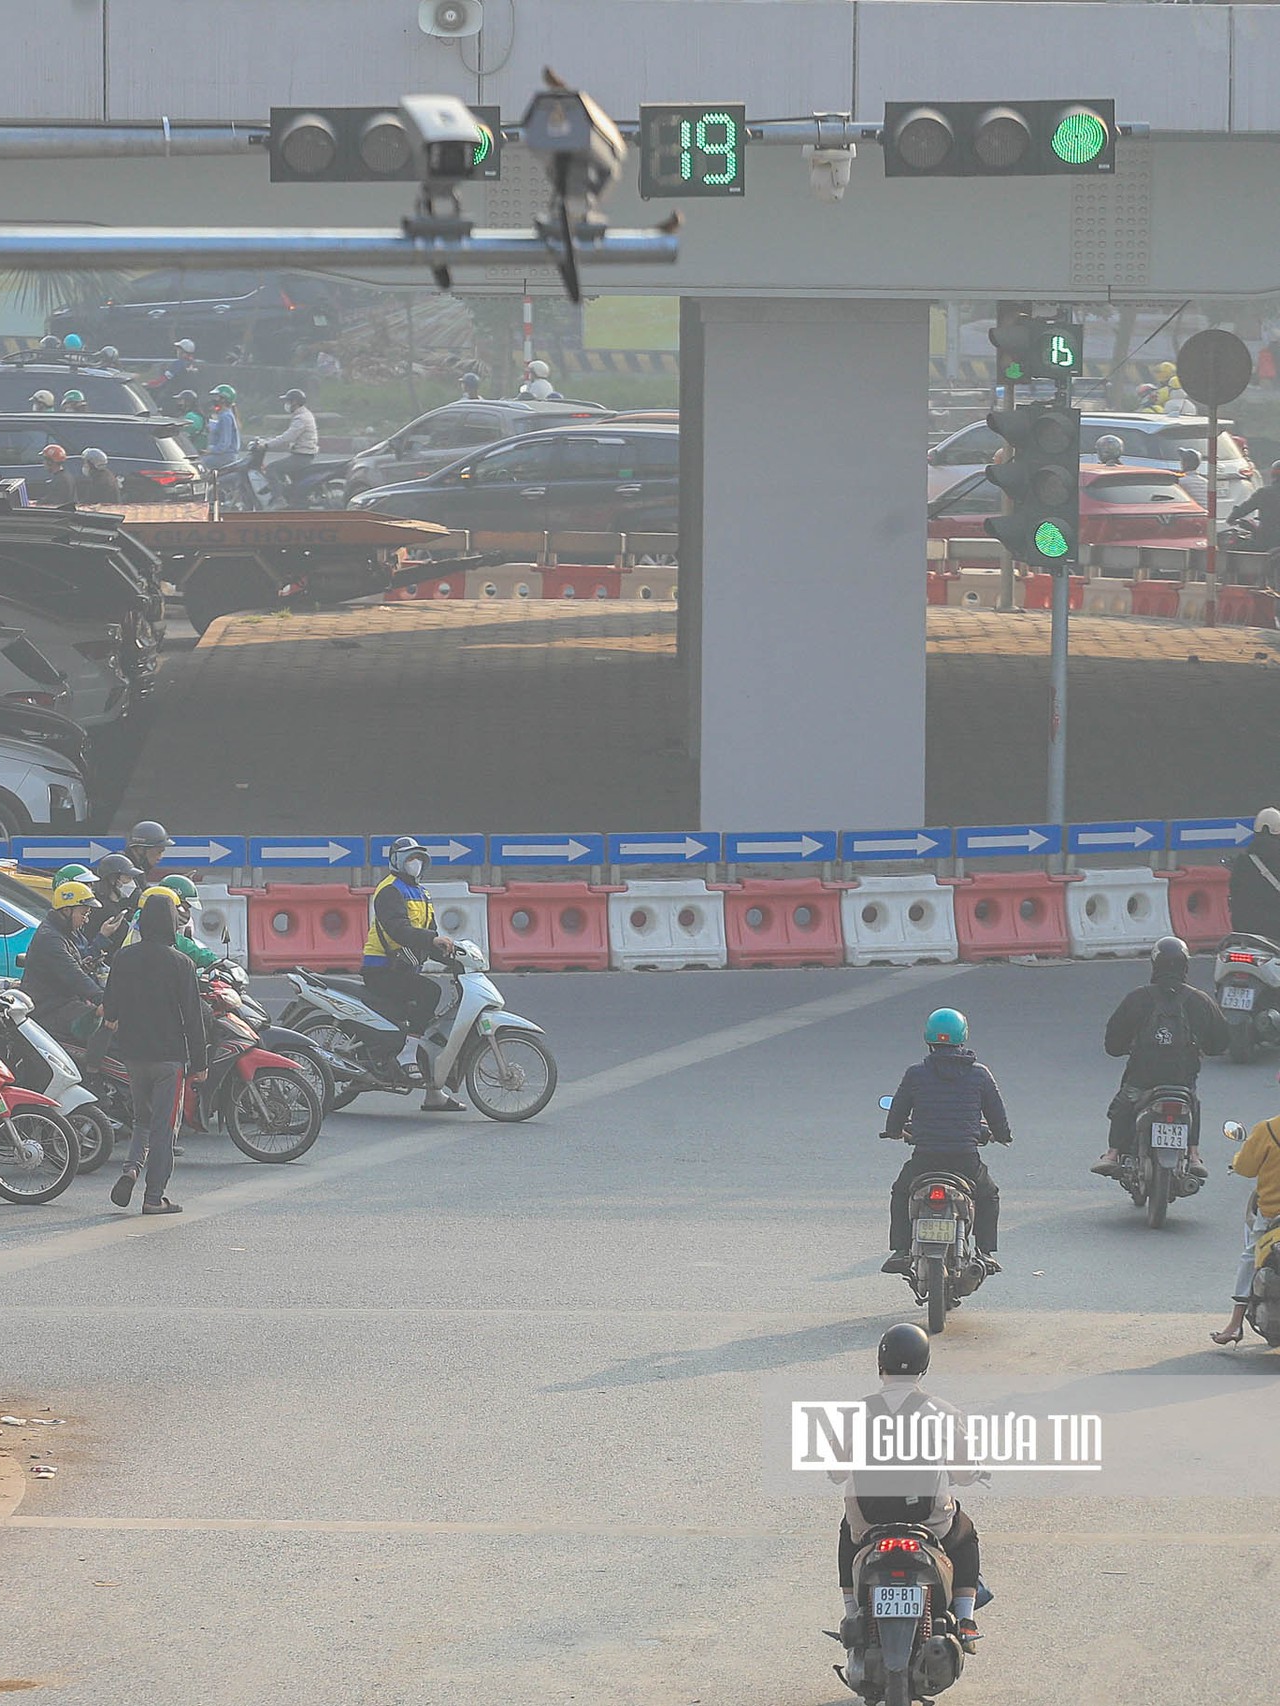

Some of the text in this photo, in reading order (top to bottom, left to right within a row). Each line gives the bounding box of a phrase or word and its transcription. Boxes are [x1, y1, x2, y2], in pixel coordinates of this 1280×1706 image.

[681, 113, 736, 185] 19
[1051, 336, 1074, 366] 15
[881, 1588, 915, 1601] 89-B1
[876, 1602, 920, 1615] 821.09
